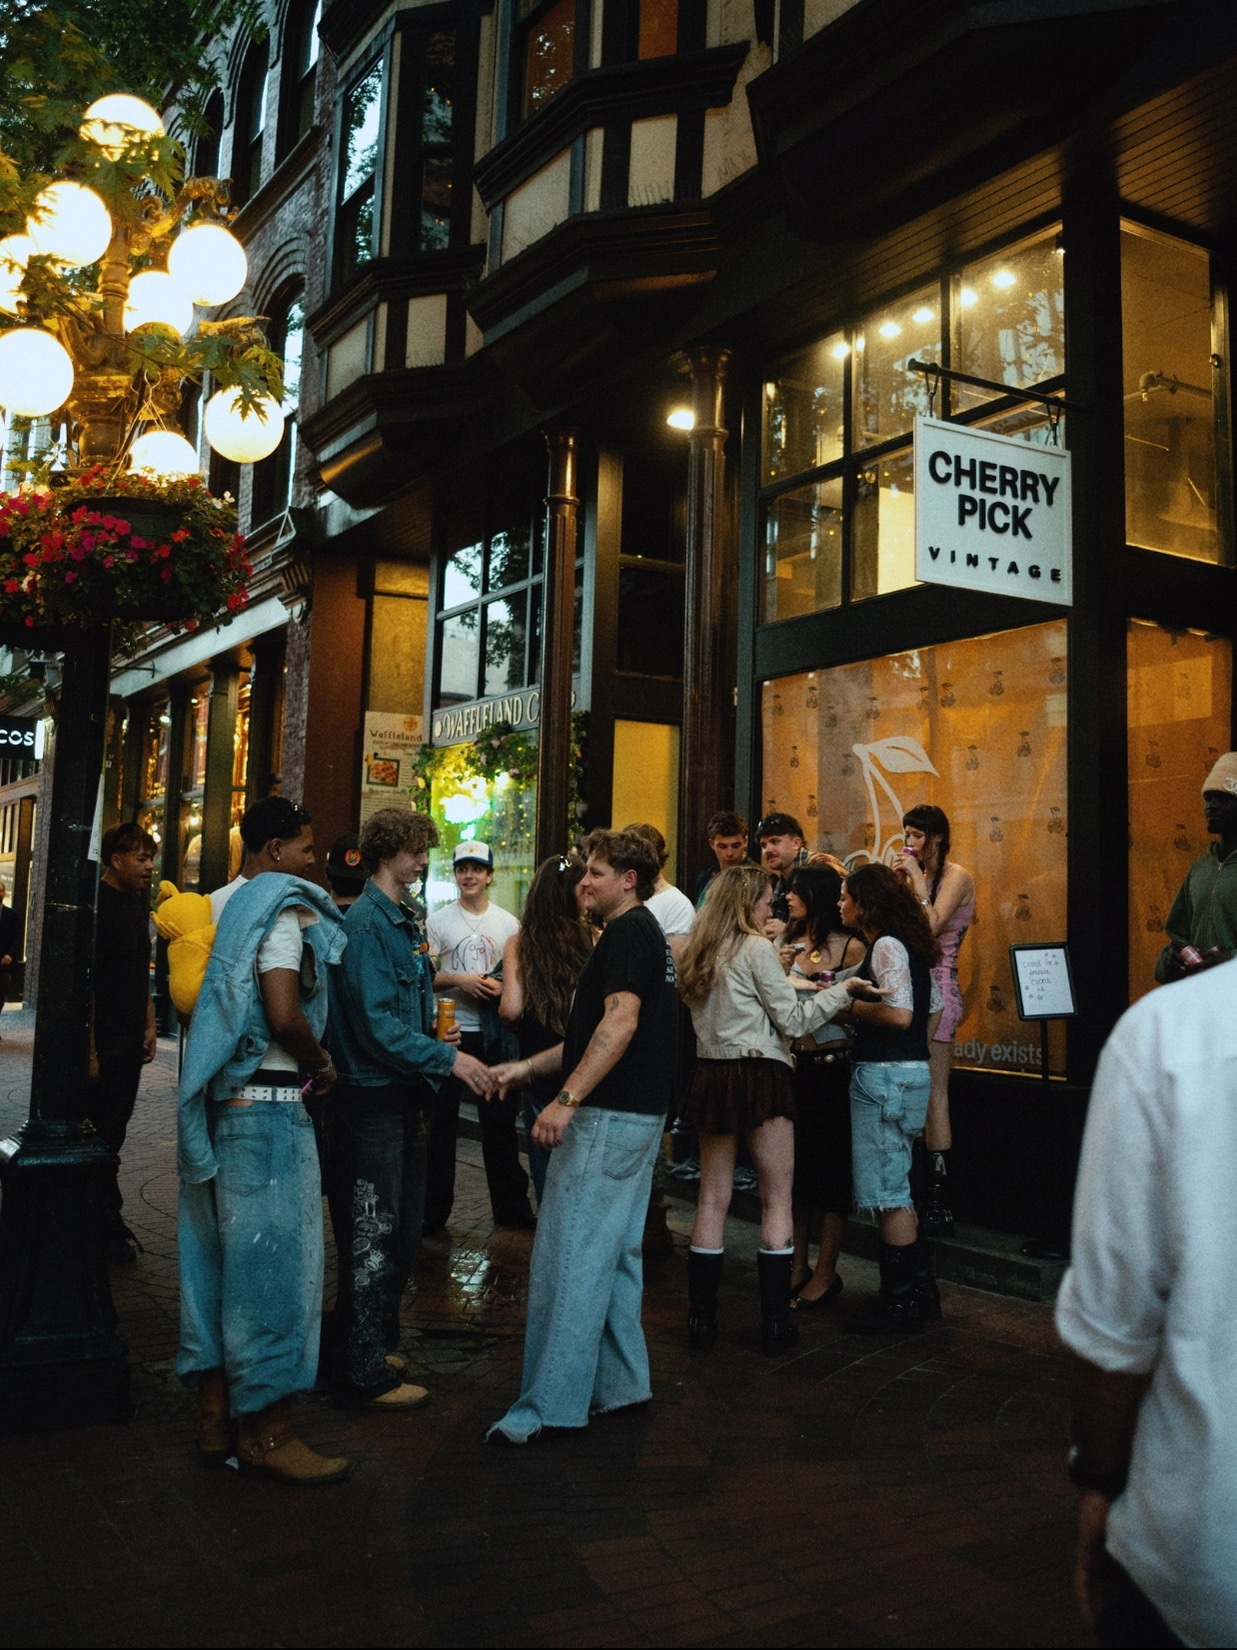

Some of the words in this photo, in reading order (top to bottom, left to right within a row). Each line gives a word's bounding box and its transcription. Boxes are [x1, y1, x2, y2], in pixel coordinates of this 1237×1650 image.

[928, 450, 1060, 506] CHERRY
[957, 493, 1033, 540] PICK
[928, 546, 1062, 582] VINTAGE
[990, 1041, 1042, 1065] exists
